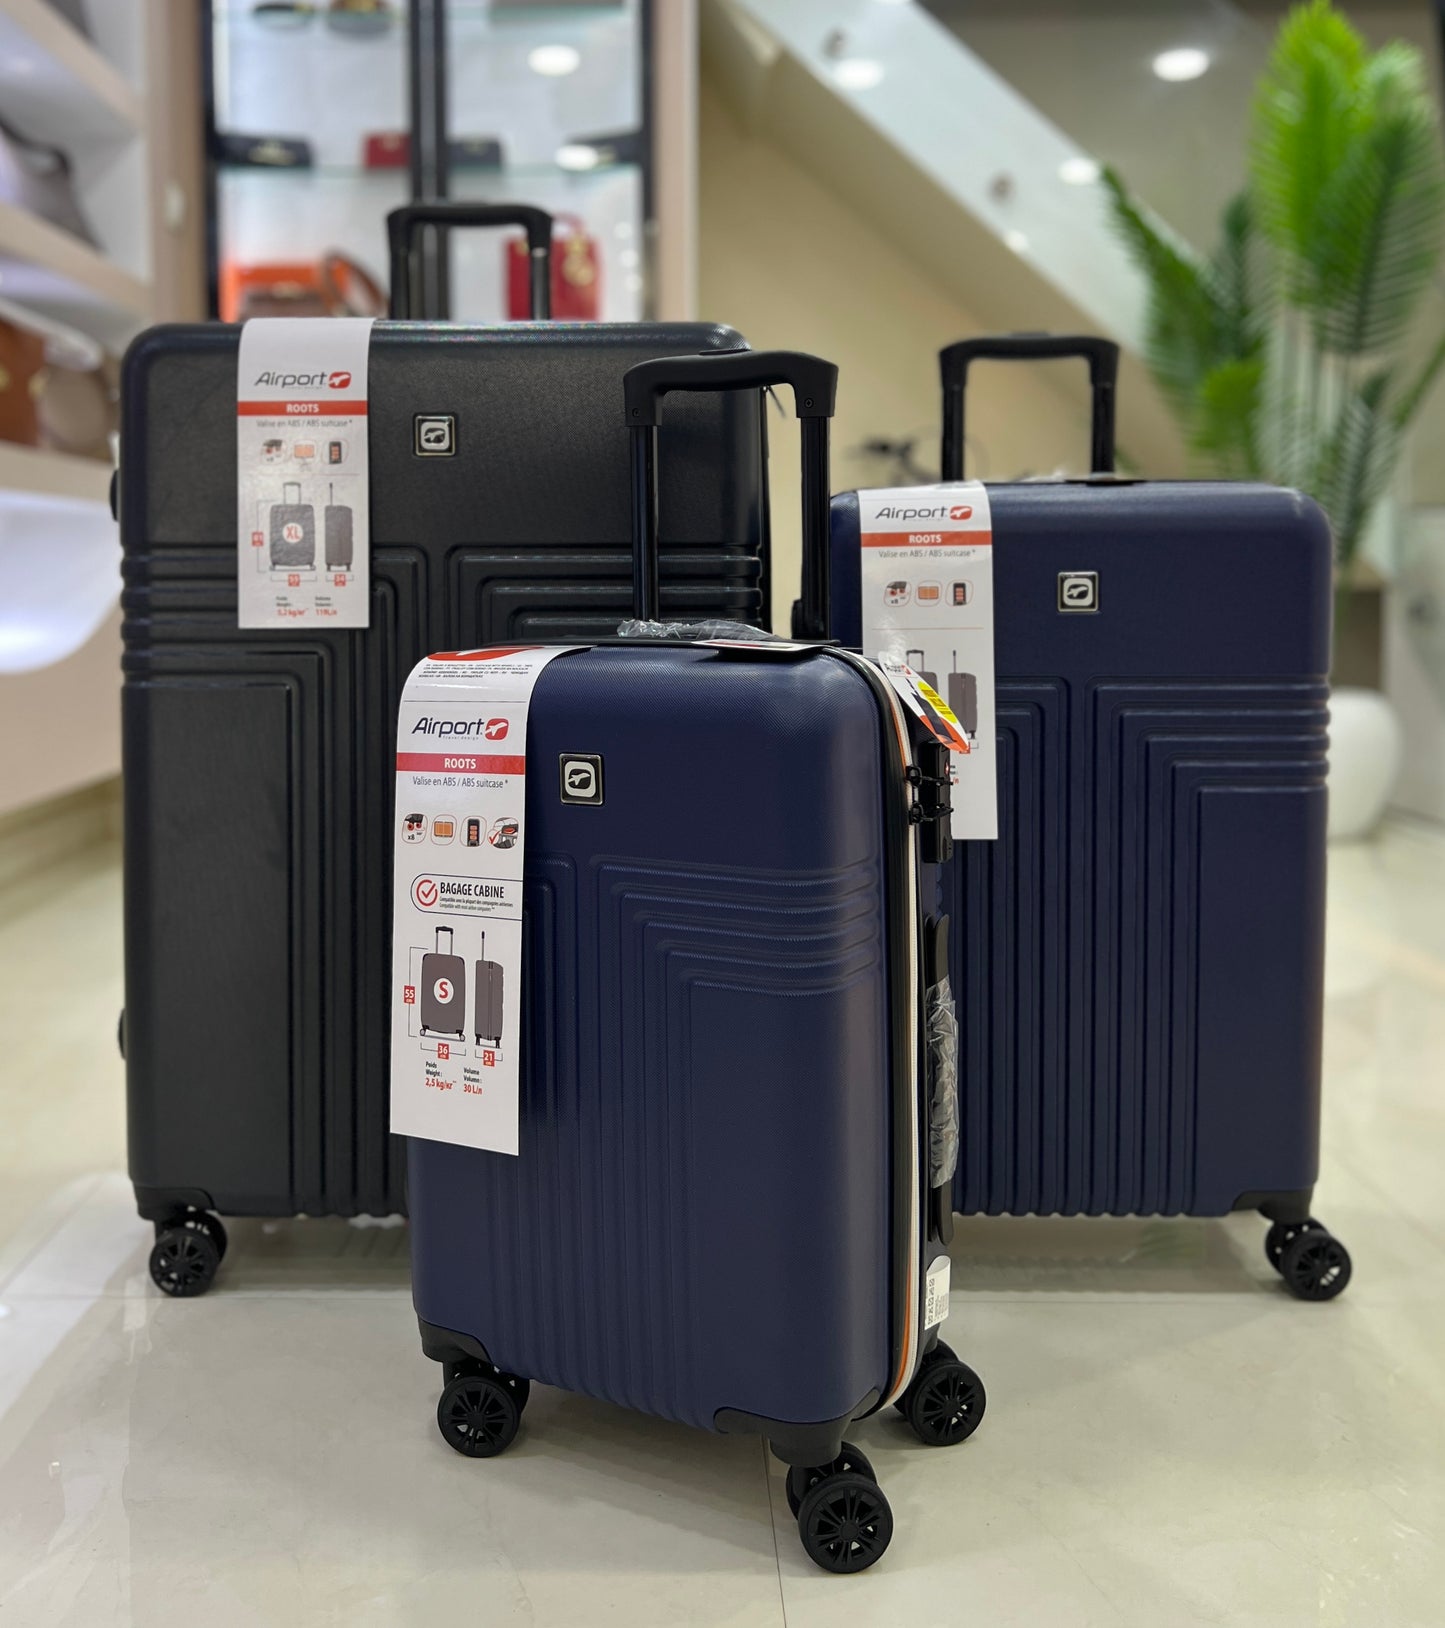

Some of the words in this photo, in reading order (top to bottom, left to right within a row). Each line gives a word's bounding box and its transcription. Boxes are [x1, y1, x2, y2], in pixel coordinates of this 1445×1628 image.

[254, 371, 327, 388] Airport
[286, 403, 319, 413] ROOTS
[875, 506, 947, 520] Airport
[286, 525, 300, 540] XL
[909, 534, 942, 543] ROOTS
[411, 717, 484, 738] Airport
[444, 757, 476, 769] ROOTS
[412, 775, 432, 786] Valise
[432, 778, 442, 786] en
[443, 777, 457, 787] ABS
[462, 778, 475, 788] ABS
[476, 778, 504, 789] suitcase
[440, 882, 472, 896] BAGAGE
[474, 885, 504, 899] CABINE
[404, 989, 415, 998] 55
[439, 981, 448, 999] S
[439, 1045, 448, 1054] 36
[484, 1052, 493, 1061] 21
[425, 1078, 435, 1088] 2,5
[463, 1084, 472, 1093] 30
